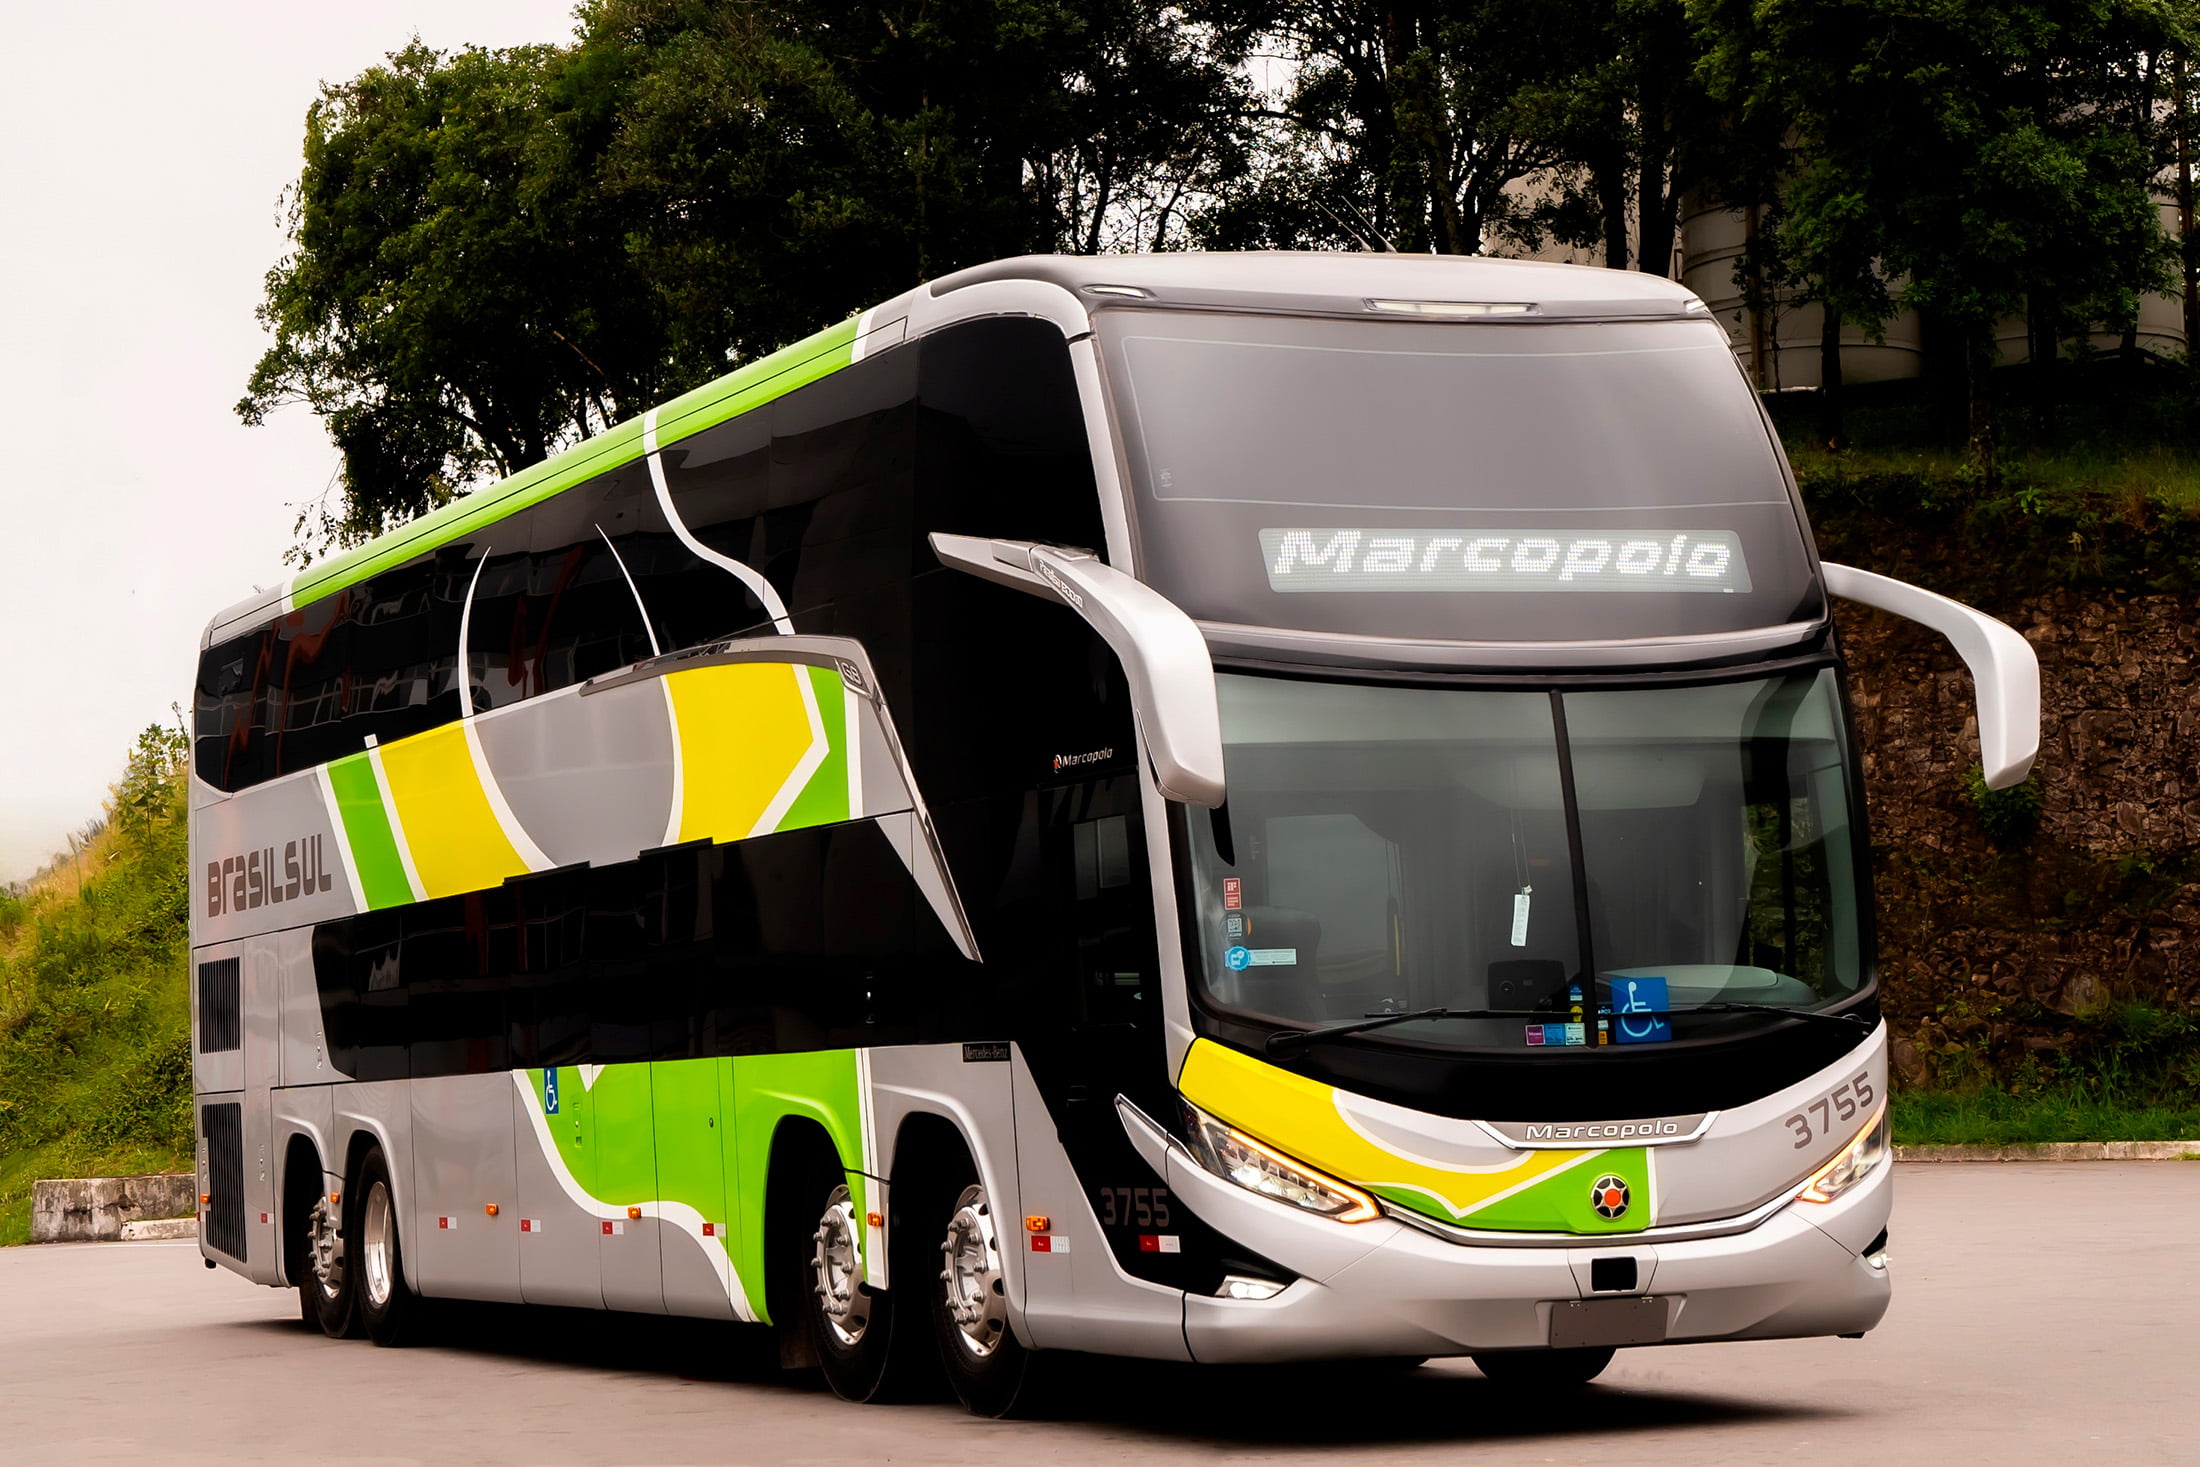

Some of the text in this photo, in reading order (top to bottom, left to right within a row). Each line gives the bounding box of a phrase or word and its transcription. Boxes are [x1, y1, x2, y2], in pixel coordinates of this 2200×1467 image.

[1274, 530, 1731, 581] Marcopolo
[1062, 747, 1113, 767] Marcopolo
[1525, 1120, 1679, 1140] Marcopolo
[1785, 1071, 1874, 1149] 3755
[1100, 1187, 1170, 1227] 3755
